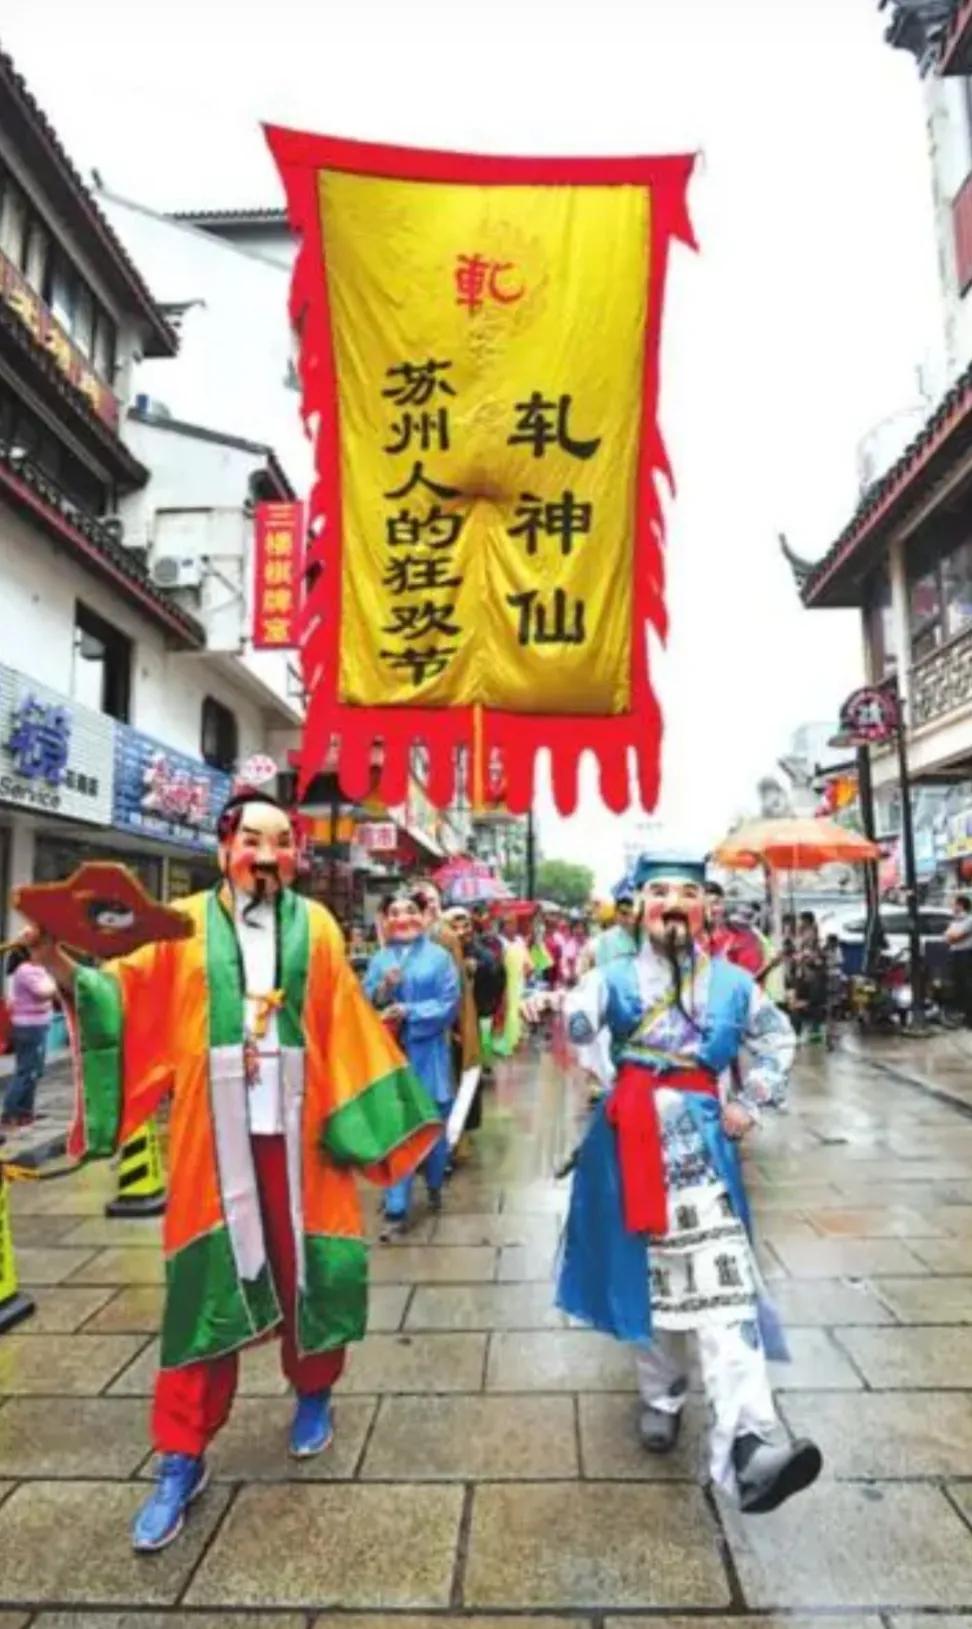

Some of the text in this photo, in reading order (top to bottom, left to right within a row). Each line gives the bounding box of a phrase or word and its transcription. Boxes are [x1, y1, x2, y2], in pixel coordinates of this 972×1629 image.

[379, 358, 464, 686] 苏州人的狂欢节
[507, 391, 602, 646] 轧神仙
